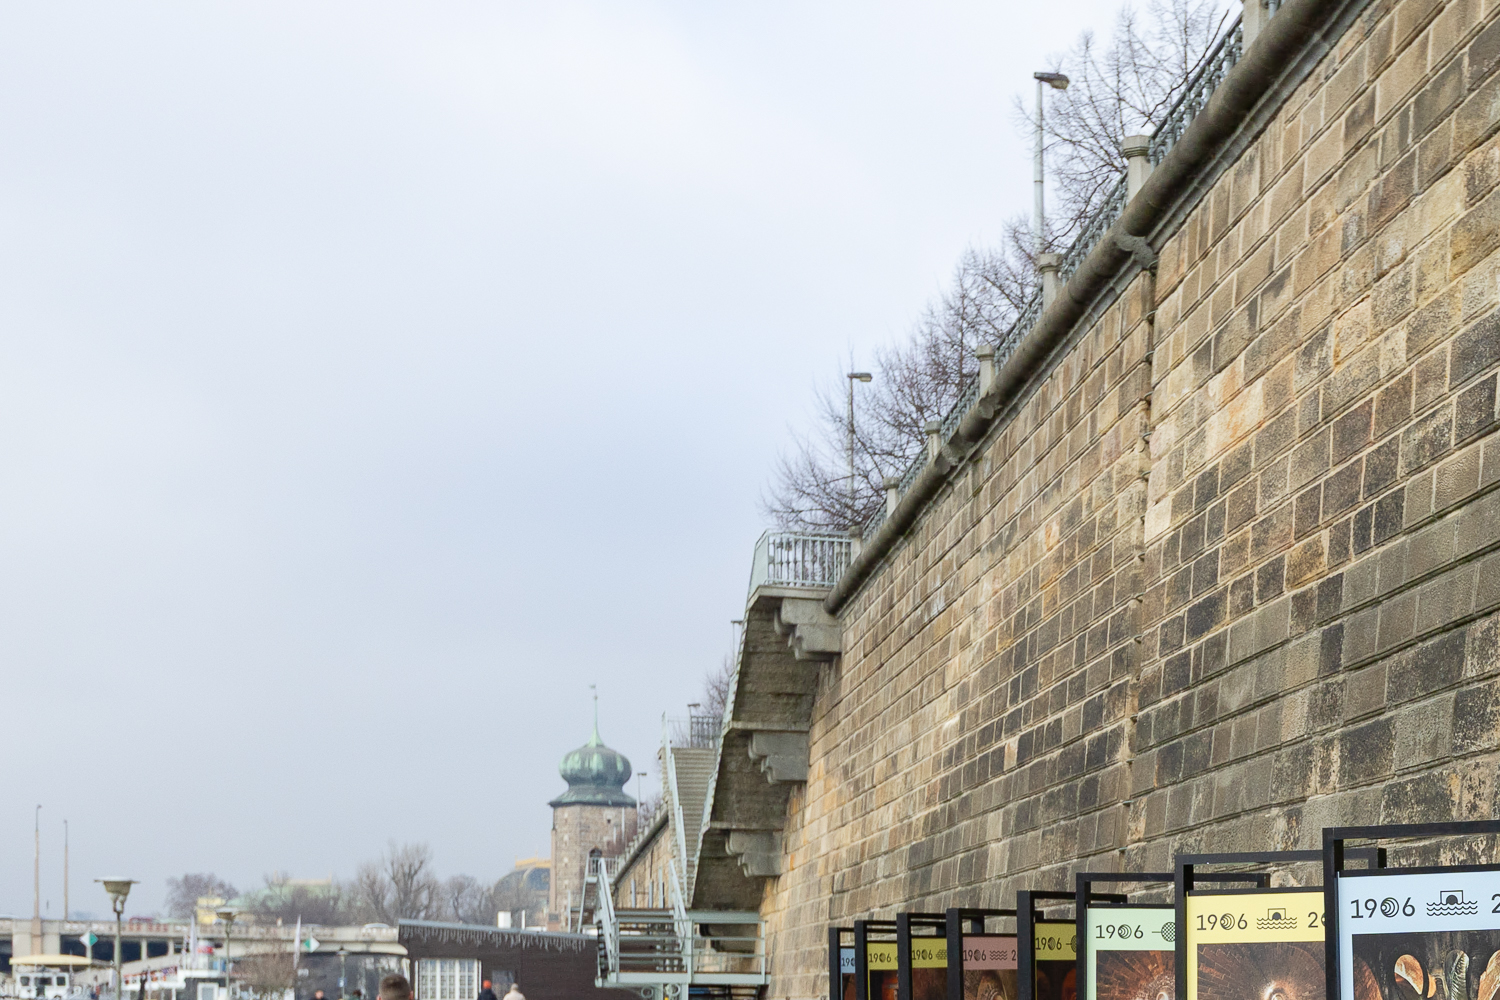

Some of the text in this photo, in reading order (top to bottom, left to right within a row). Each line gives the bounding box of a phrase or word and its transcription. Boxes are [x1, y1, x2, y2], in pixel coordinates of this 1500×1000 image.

[1351, 897, 1415, 919] 1906
[1197, 913, 1248, 930] 1906
[1096, 924, 1144, 939] 1906
[1035, 937, 1062, 950] 1906
[869, 953, 891, 963] 1906
[912, 949, 933, 960] 1906
[963, 949, 986, 961] 1906
